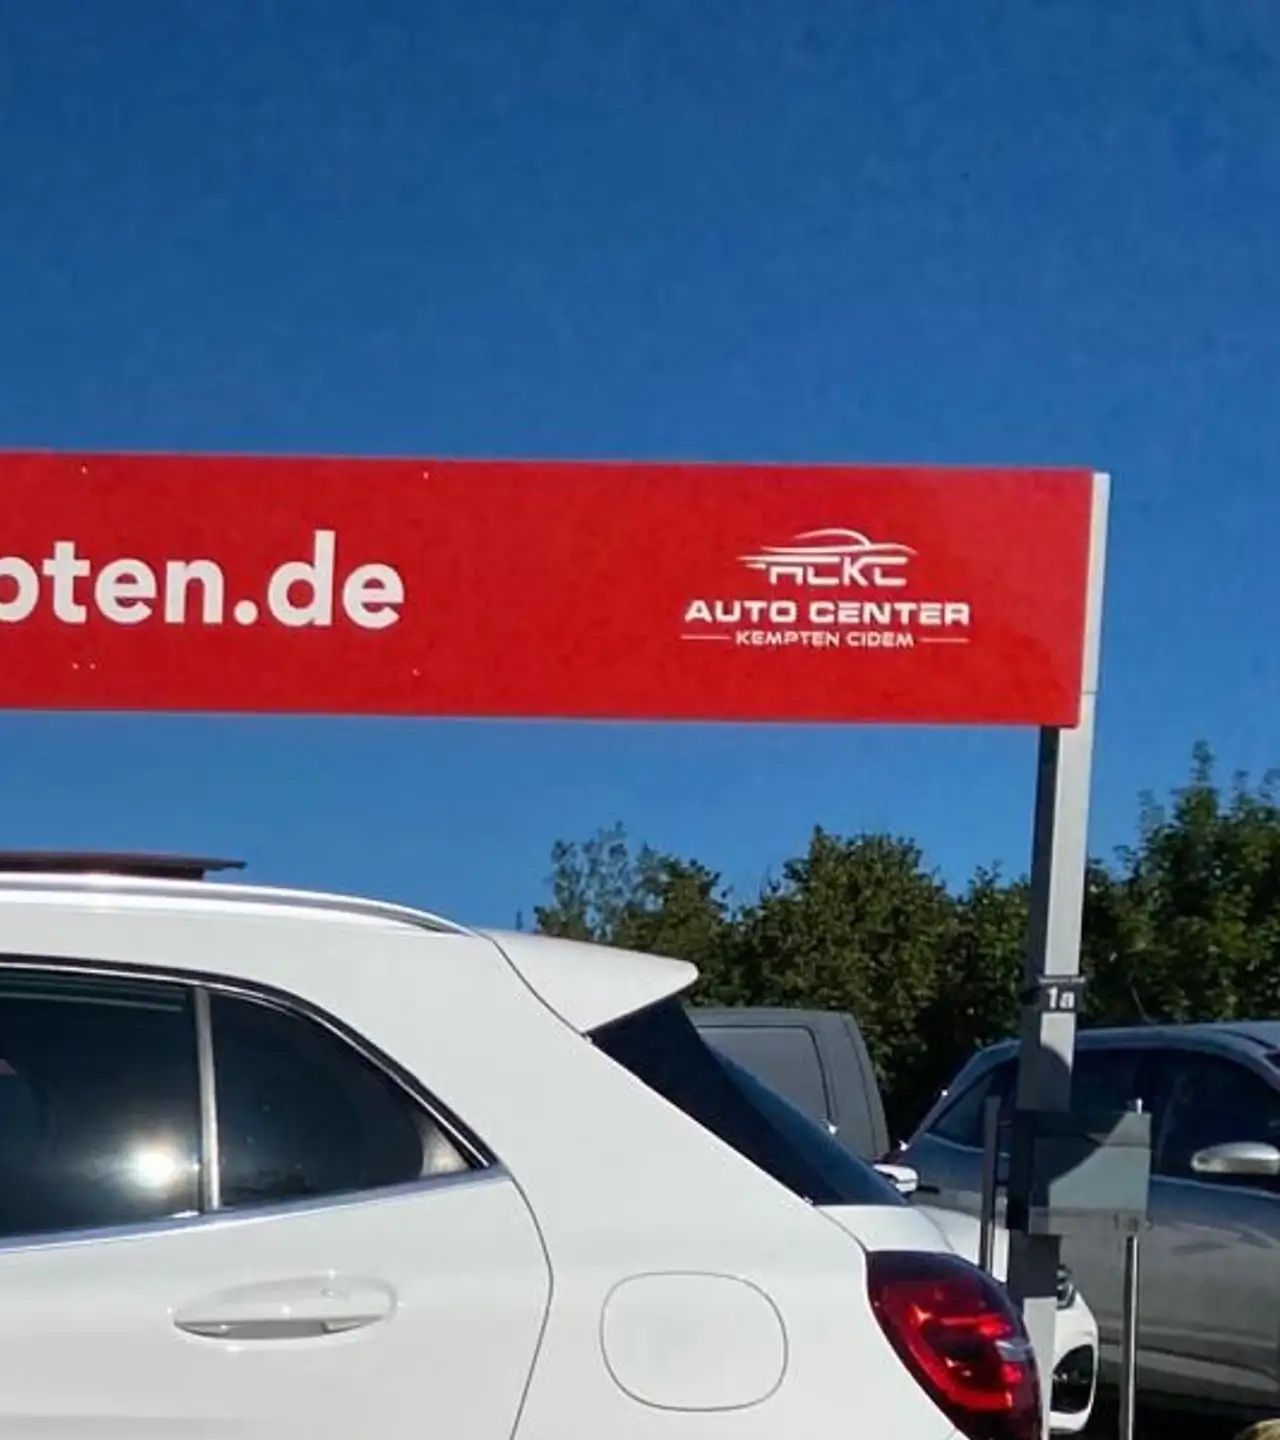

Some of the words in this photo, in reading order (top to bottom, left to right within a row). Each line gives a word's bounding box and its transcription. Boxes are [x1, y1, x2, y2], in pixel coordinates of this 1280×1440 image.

[684, 599, 797, 624] AUTO
[808, 601, 971, 626] CENTER
[735, 630, 840, 648] KEMPTEN
[844, 631, 915, 649] CIDEM
